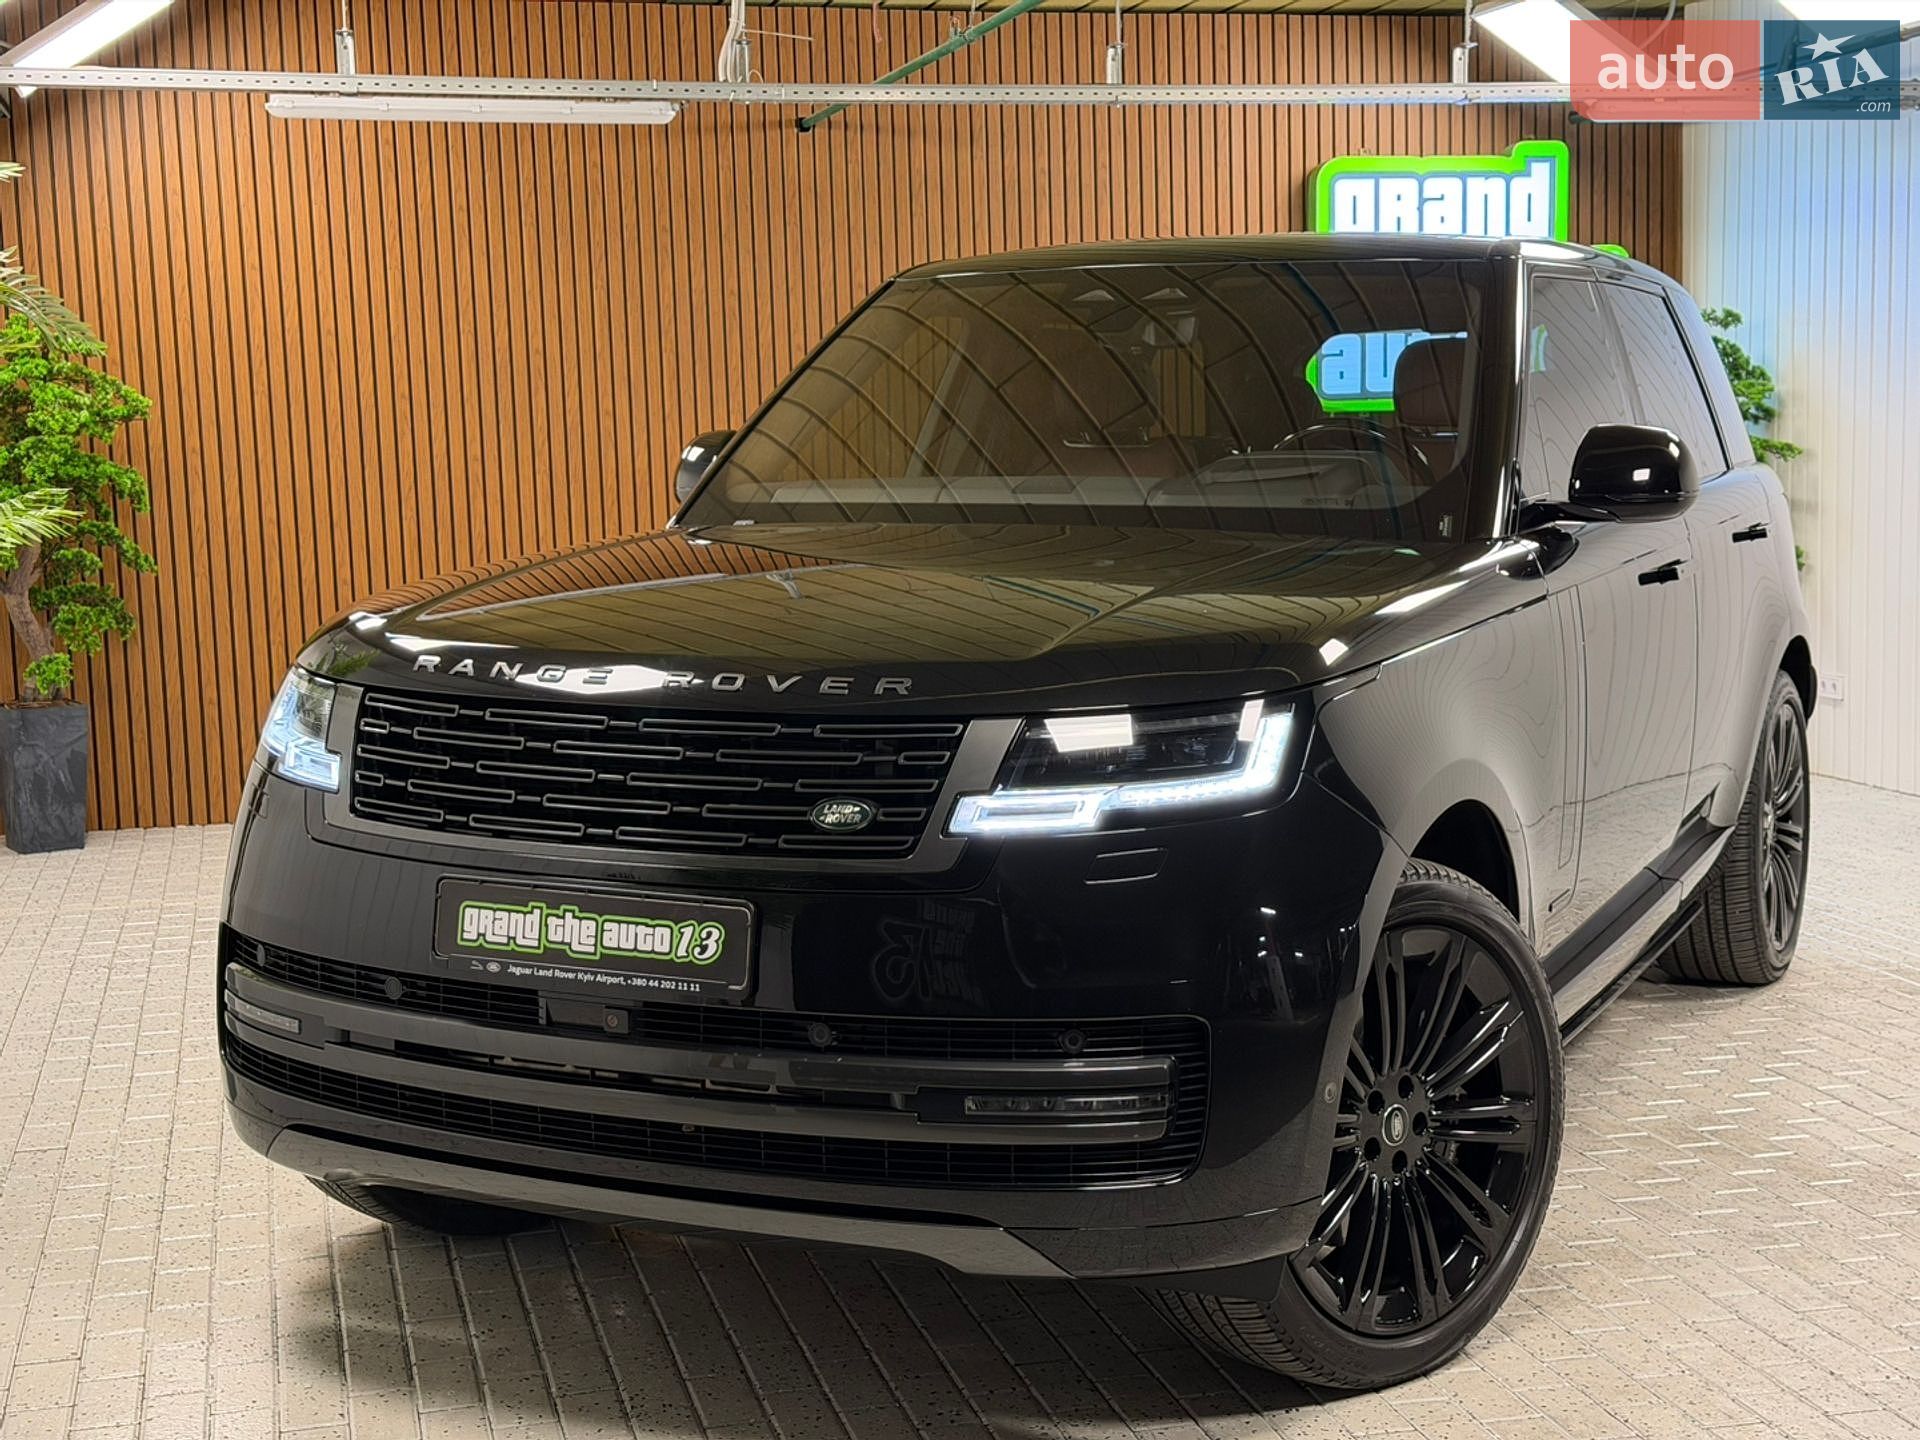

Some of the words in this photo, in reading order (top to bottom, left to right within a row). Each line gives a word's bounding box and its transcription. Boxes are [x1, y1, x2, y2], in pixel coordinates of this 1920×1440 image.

[413, 655, 613, 685] RANGE
[661, 670, 912, 696] ROVER
[823, 804, 854, 814] LAND
[824, 813, 862, 824] ROVER
[462, 907, 541, 947] grand
[547, 911, 597, 954] the
[602, 921, 672, 954] auto
[677, 925, 720, 960] 13
[507, 964, 533, 976] Jaguar
[533, 967, 553, 977] Land
[554, 969, 577, 980] Rover
[577, 971, 595, 983] Kyiv
[648, 979, 659, 988] 44
[660, 980, 676, 990] 202
[677, 982, 688, 991] 11
[689, 983, 701, 992] 11
